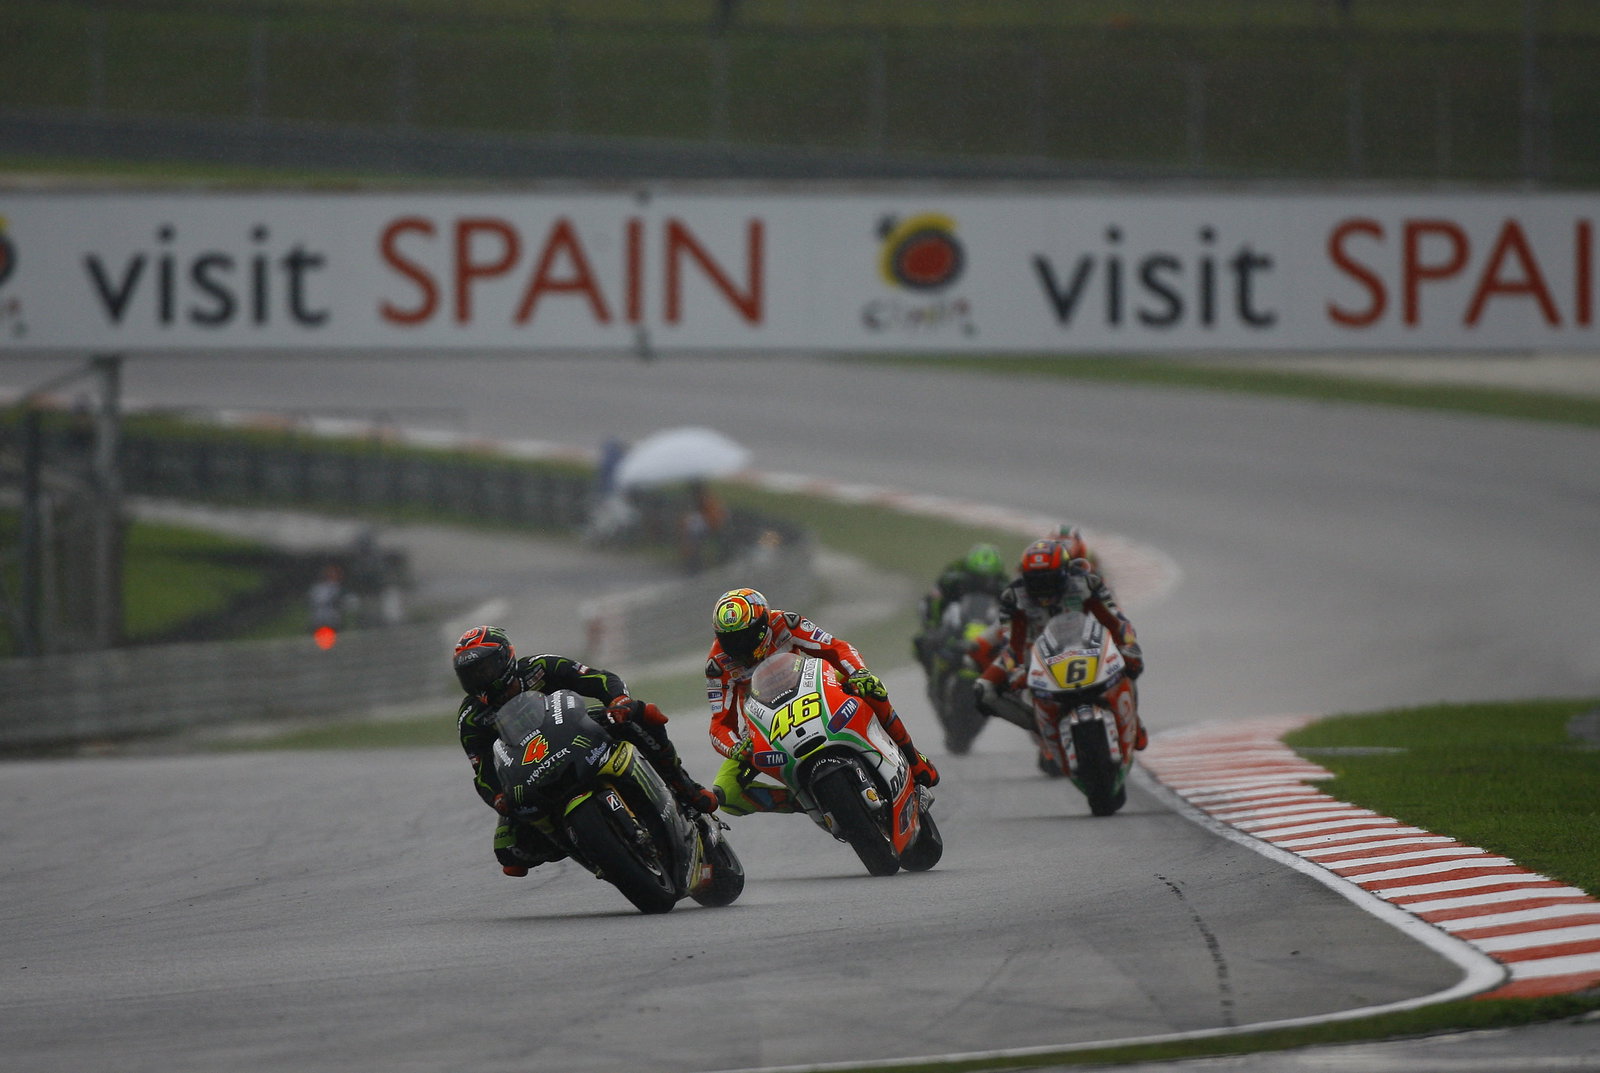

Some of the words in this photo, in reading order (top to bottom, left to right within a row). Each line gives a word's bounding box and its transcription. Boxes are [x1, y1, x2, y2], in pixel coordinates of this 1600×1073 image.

[83, 225, 329, 328] visit
[379, 216, 764, 328] SPAIN
[1032, 226, 1277, 329] visit
[1065, 658, 1087, 684] 6
[769, 692, 822, 745] 46
[841, 700, 857, 719] TIM
[520, 729, 541, 747] YAMAHA
[521, 734, 550, 766] 4
[526, 747, 572, 785] MONSTER
[766, 754, 784, 765] TIM
